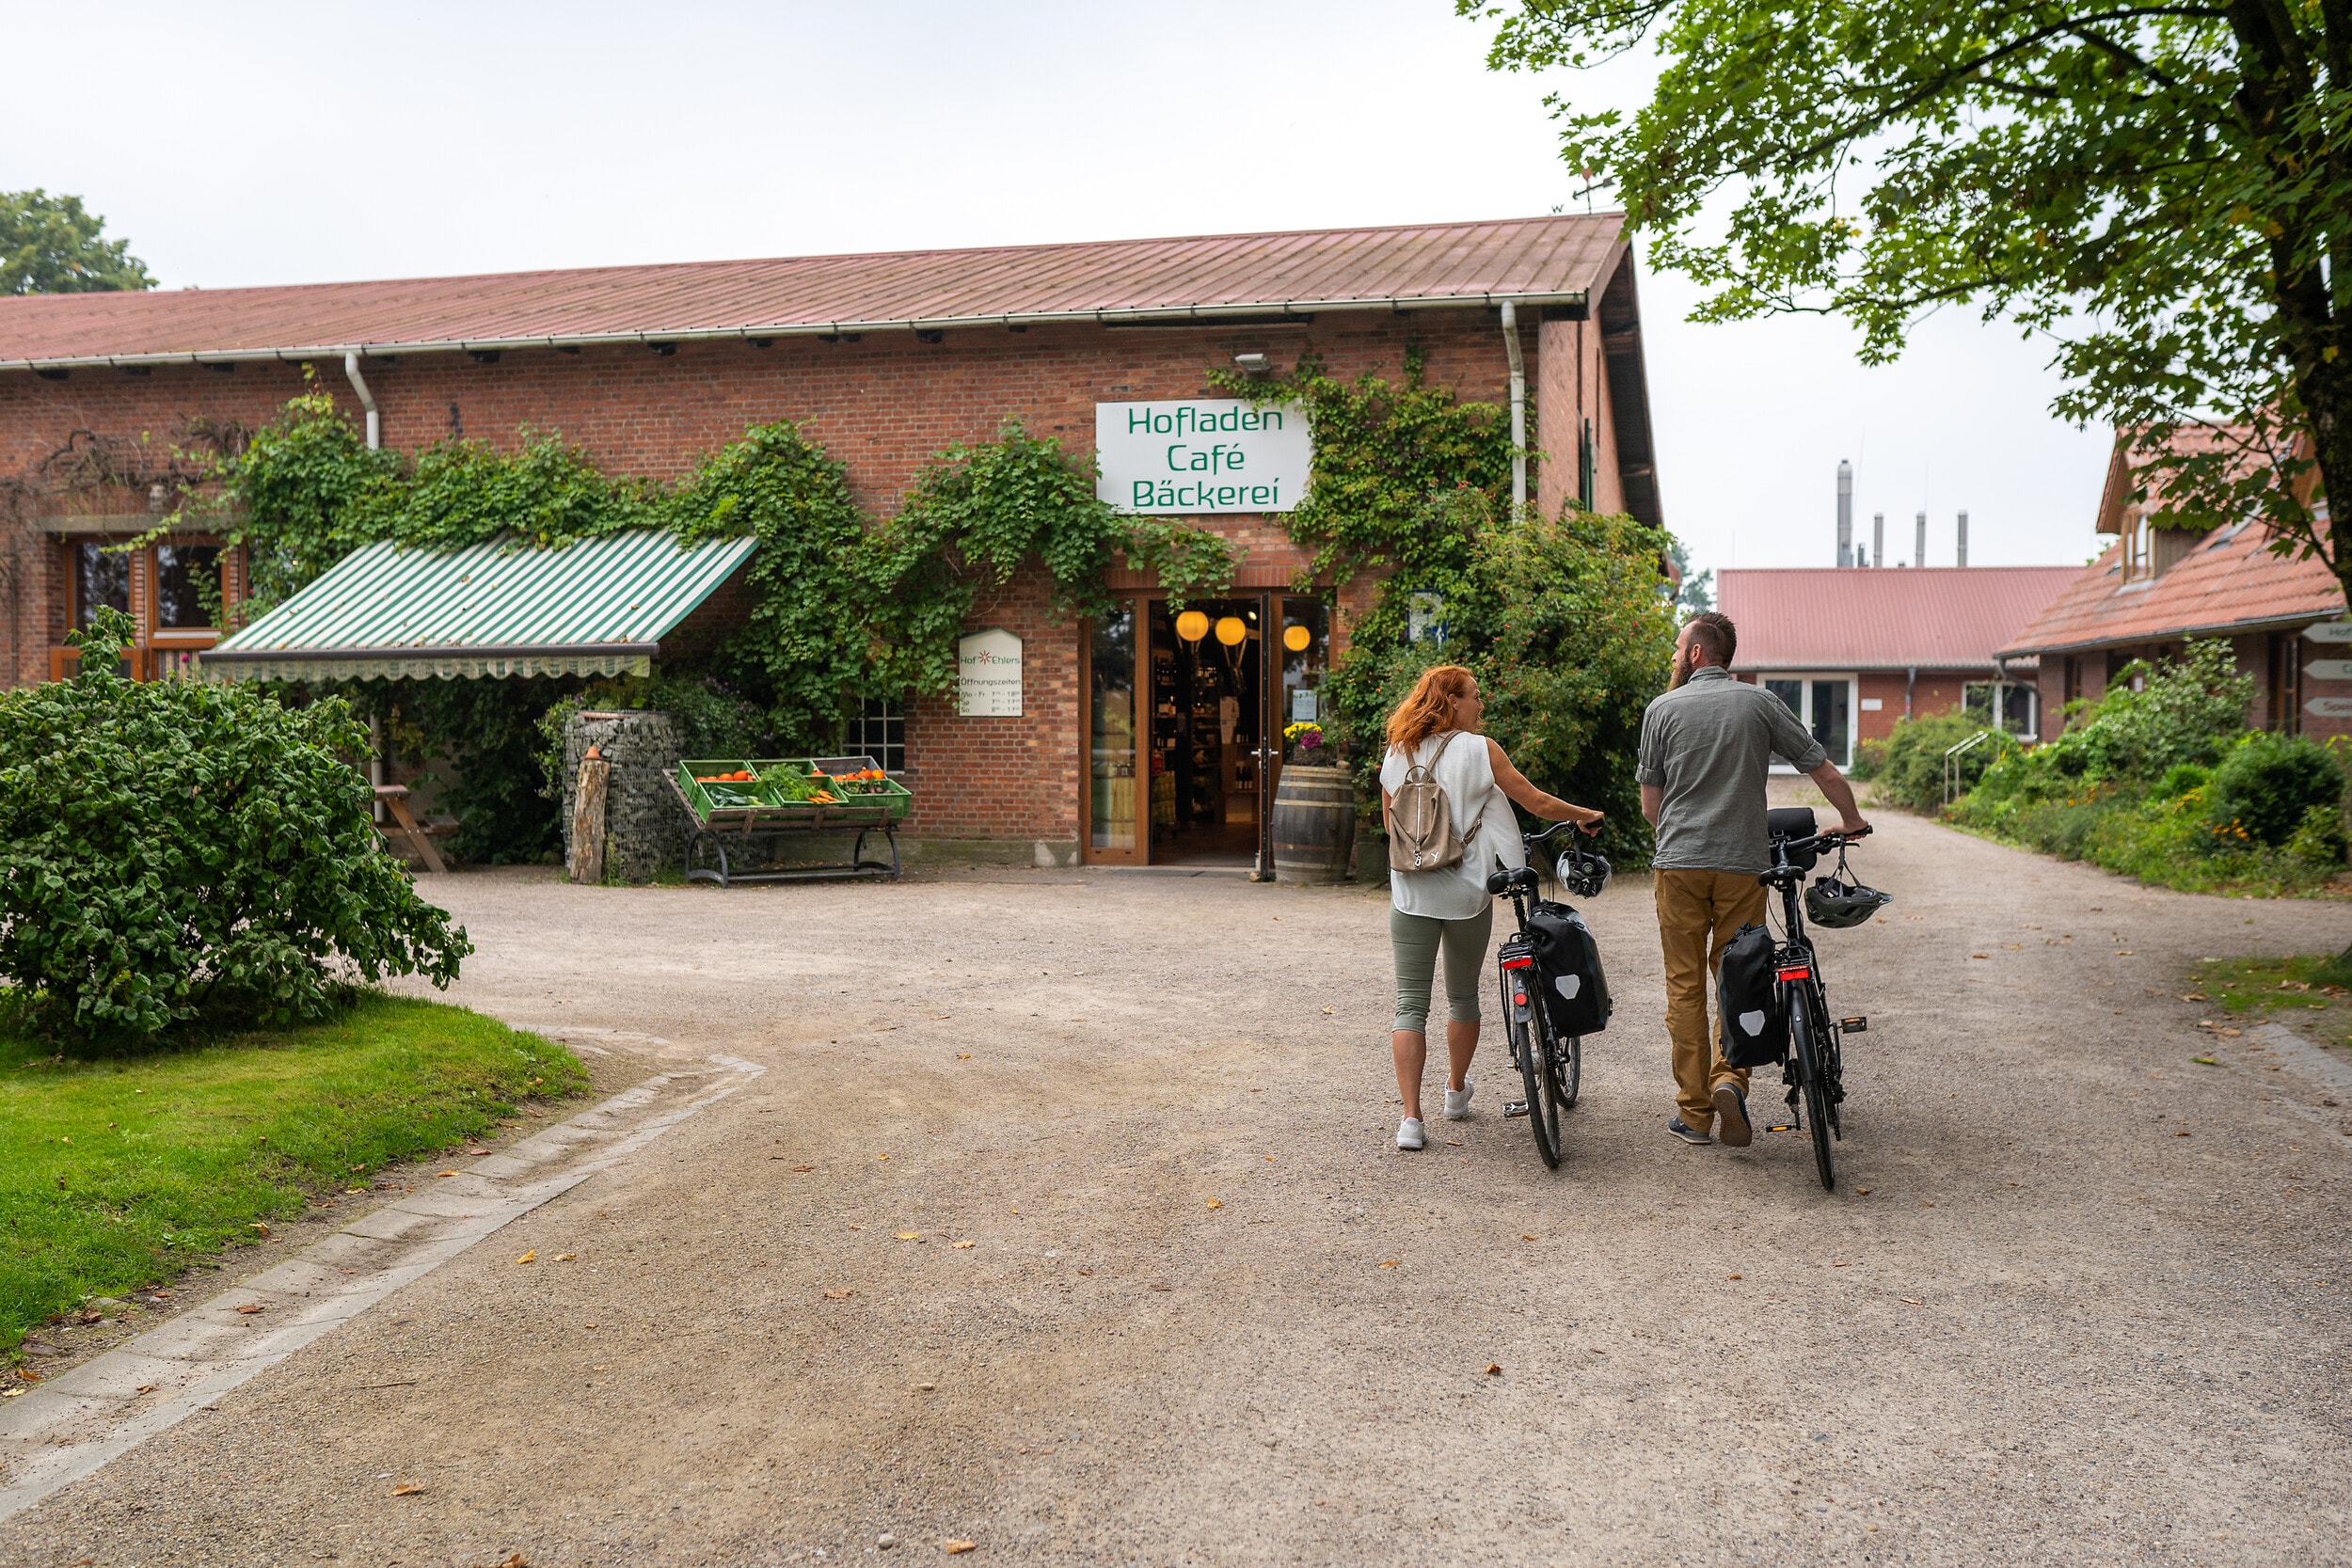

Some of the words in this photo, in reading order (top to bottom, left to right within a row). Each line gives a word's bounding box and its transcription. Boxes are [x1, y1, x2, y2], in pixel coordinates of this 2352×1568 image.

[1128, 405, 1282, 437] Hofladen
[1168, 443, 1245, 475] Café
[1133, 478, 1279, 509] Bäckerei
[960, 656, 977, 665] Hof
[992, 656, 1021, 665] Ehlers
[961, 676, 1021, 687] Öffnungszeiten
